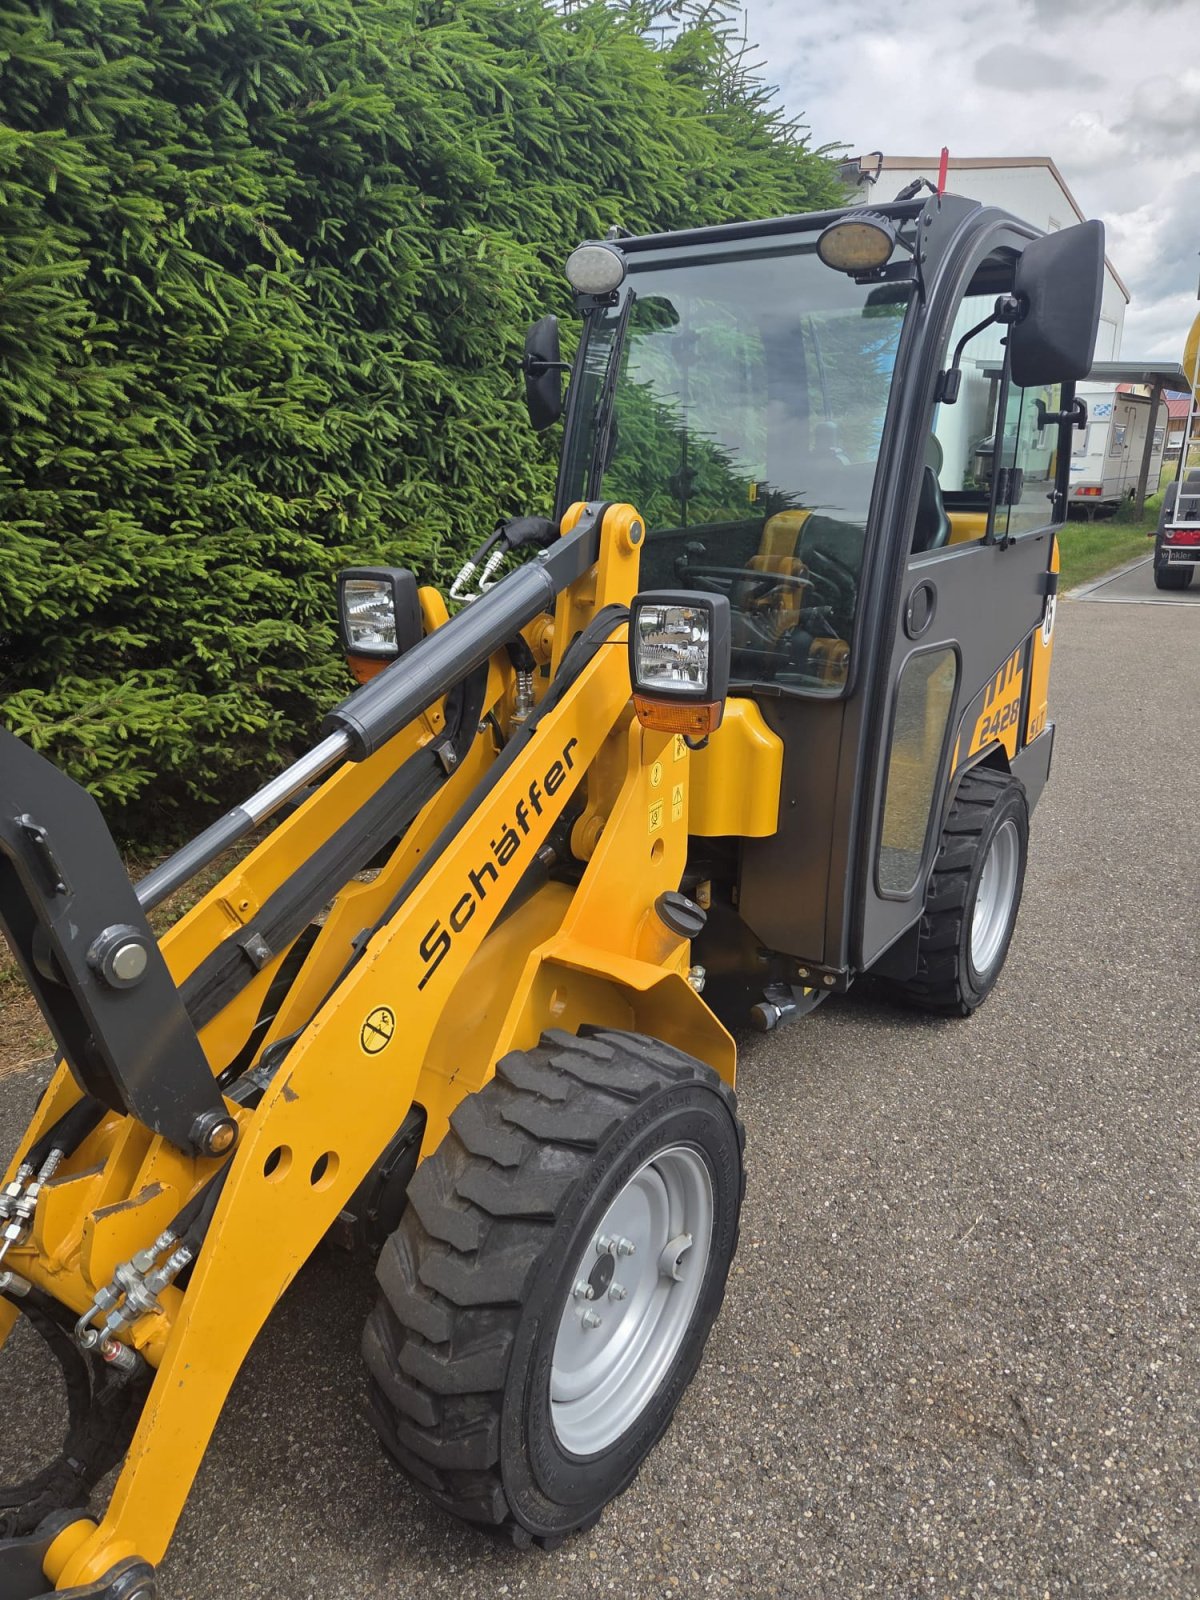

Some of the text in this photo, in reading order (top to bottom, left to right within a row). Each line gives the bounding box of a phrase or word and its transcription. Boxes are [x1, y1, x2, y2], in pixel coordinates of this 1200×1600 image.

[1161, 551, 1190, 560] wnkler
[978, 698, 1020, 746] 2428
[417, 737, 578, 991] Schäffer
